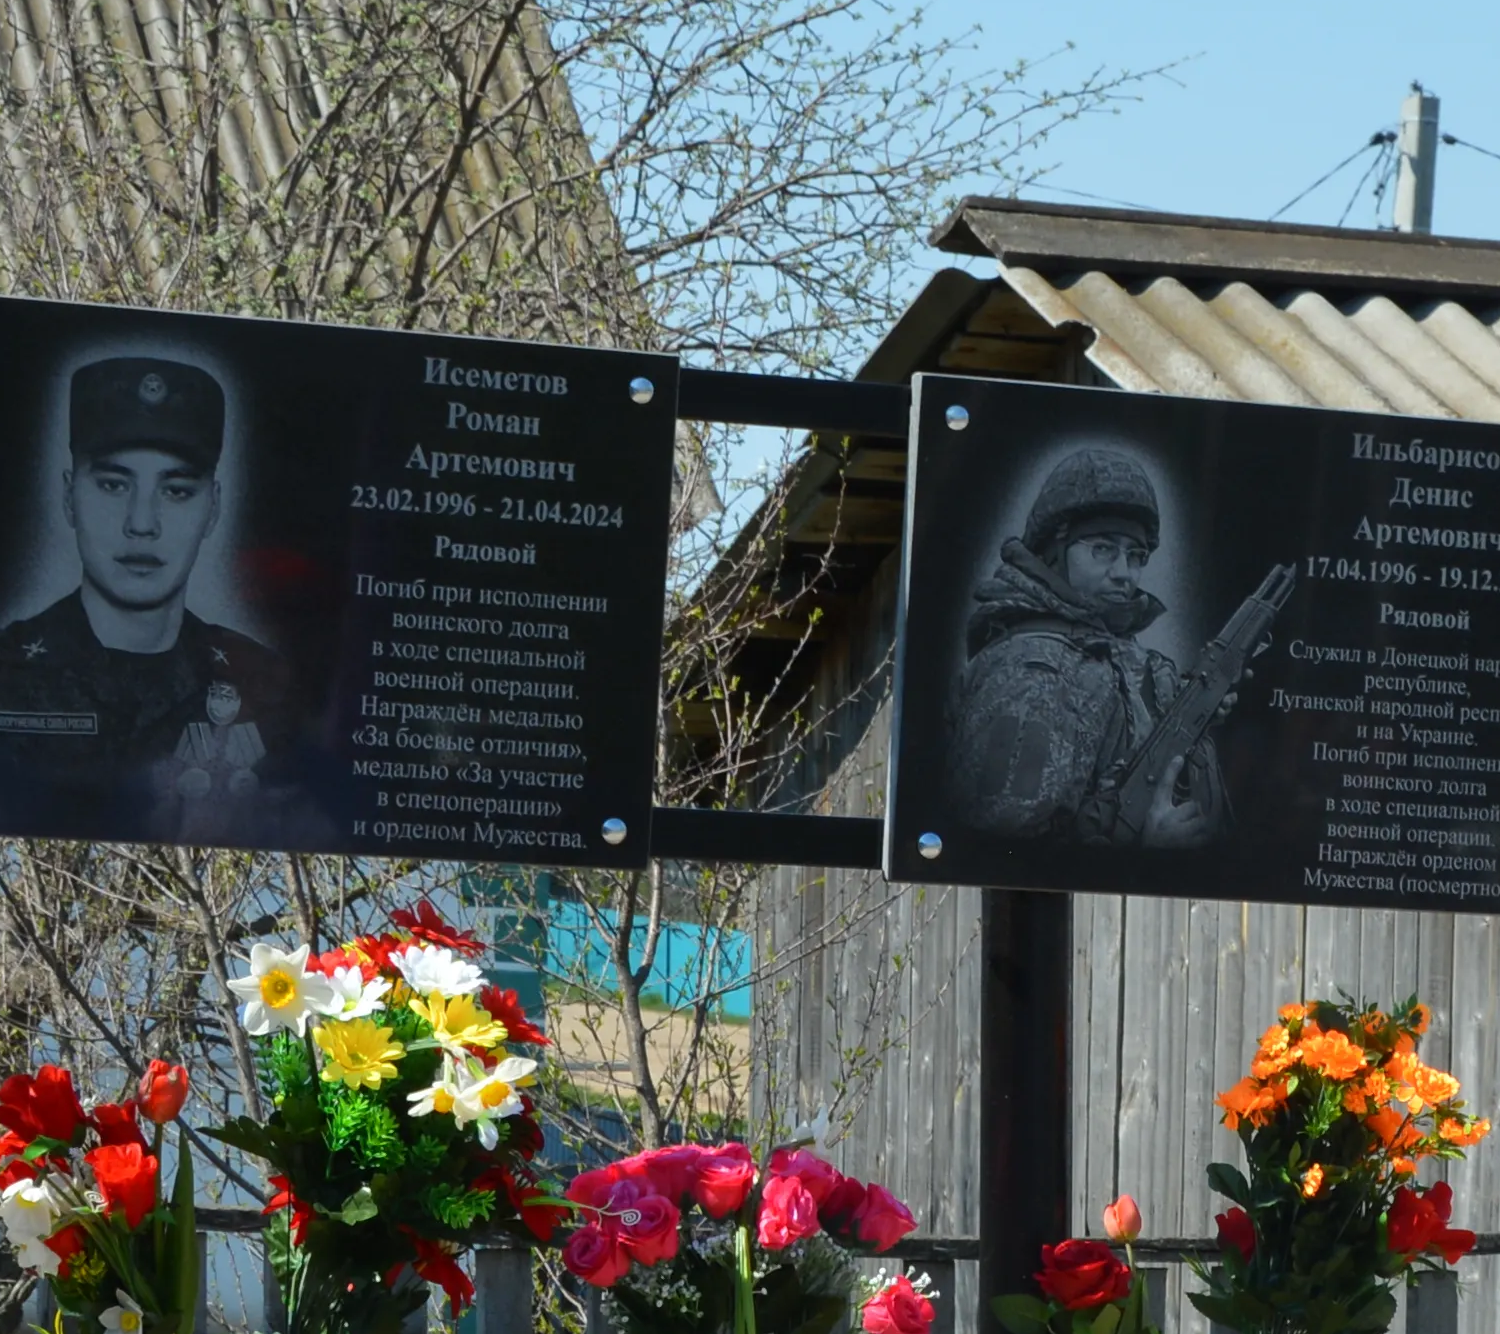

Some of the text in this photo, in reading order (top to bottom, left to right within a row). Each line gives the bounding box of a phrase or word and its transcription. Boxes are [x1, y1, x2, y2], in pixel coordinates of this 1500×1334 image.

[423, 356, 568, 395] Исеметов
[446, 401, 540, 436] Роман
[404, 442, 575, 482] Артемович
[350, 484, 476, 516] 23.02.1996
[499, 496, 623, 528] 21.04.2024
[1388, 476, 1473, 508] Денис
[434, 534, 536, 564] Рядовой
[1307, 555, 1417, 585] 17.04.1996
[355, 573, 607, 613] Погиб при исполнении
[392, 611, 569, 640] воинского долга
[1379, 602, 1470, 630] Рядовой
[371, 640, 585, 670] в ходе специальной
[1288, 638, 1361, 664] Служил
[1366, 649, 1376, 663] в
[1380, 646, 1469, 670] Донецкой
[373, 670, 579, 701] военной операции.
[1363, 673, 1471, 698] республике,
[360, 694, 583, 730] Награждён медалью
[1268, 688, 1364, 713] Луганской
[1370, 700, 1454, 720] народной
[351, 723, 587, 761] «За боевые отличия»,
[1356, 721, 1478, 748] и на Украине.
[1312, 741, 1370, 764] Погиб
[1374, 750, 1407, 770] при
[352, 759, 584, 790] медалью «За участие
[1342, 773, 1487, 796] воинского долга
[377, 790, 562, 819] в спецоперации»
[1325, 797, 1500, 822] в ходе специальной
[353, 819, 587, 849] и орденом Мужества.
[1326, 822, 1495, 849] военной операции.
[1318, 842, 1496, 874] Награждён орденом
[1303, 866, 1394, 892] Мужества
